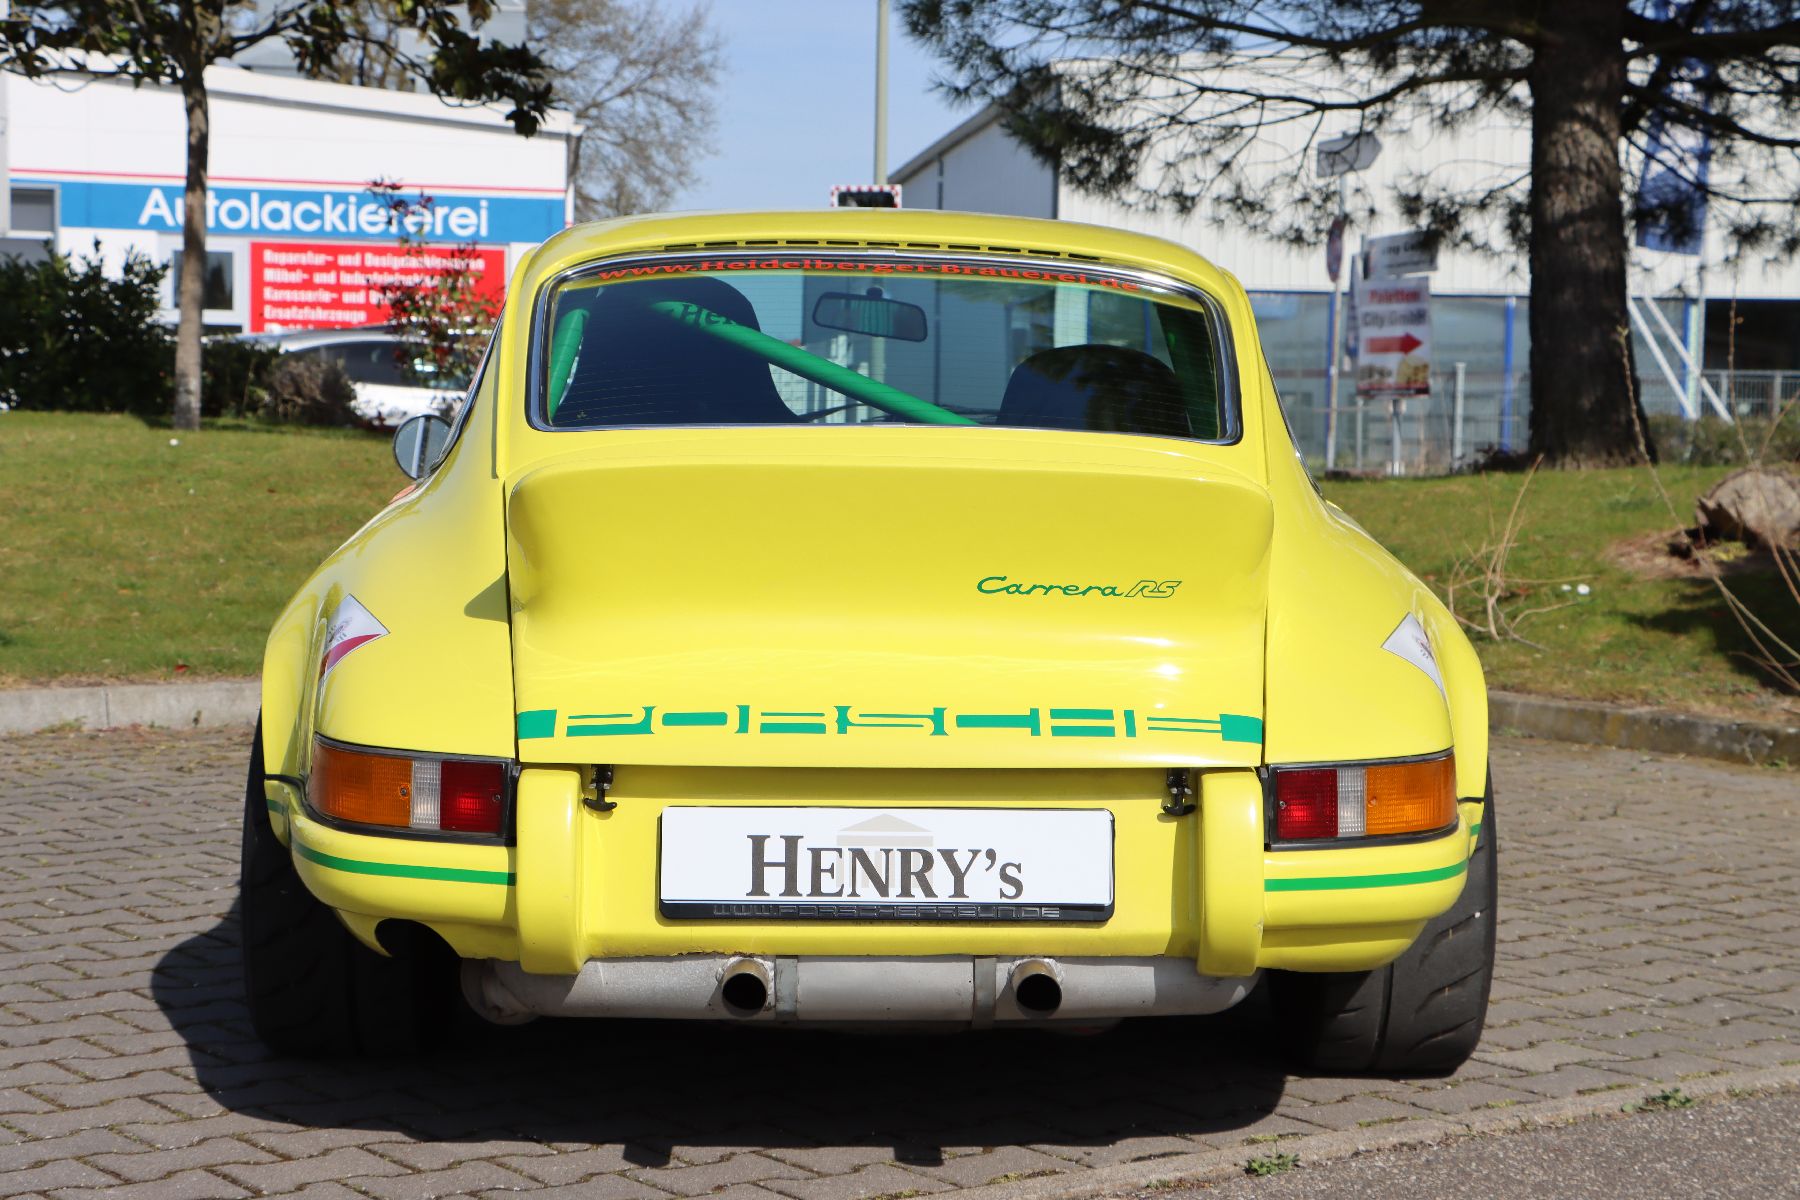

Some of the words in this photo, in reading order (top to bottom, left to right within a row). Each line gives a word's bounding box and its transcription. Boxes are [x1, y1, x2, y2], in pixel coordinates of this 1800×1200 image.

[977, 576, 1125, 597] Carrera
[1124, 579, 1183, 598] RS
[553, 704, 1222, 743] PORSCHE
